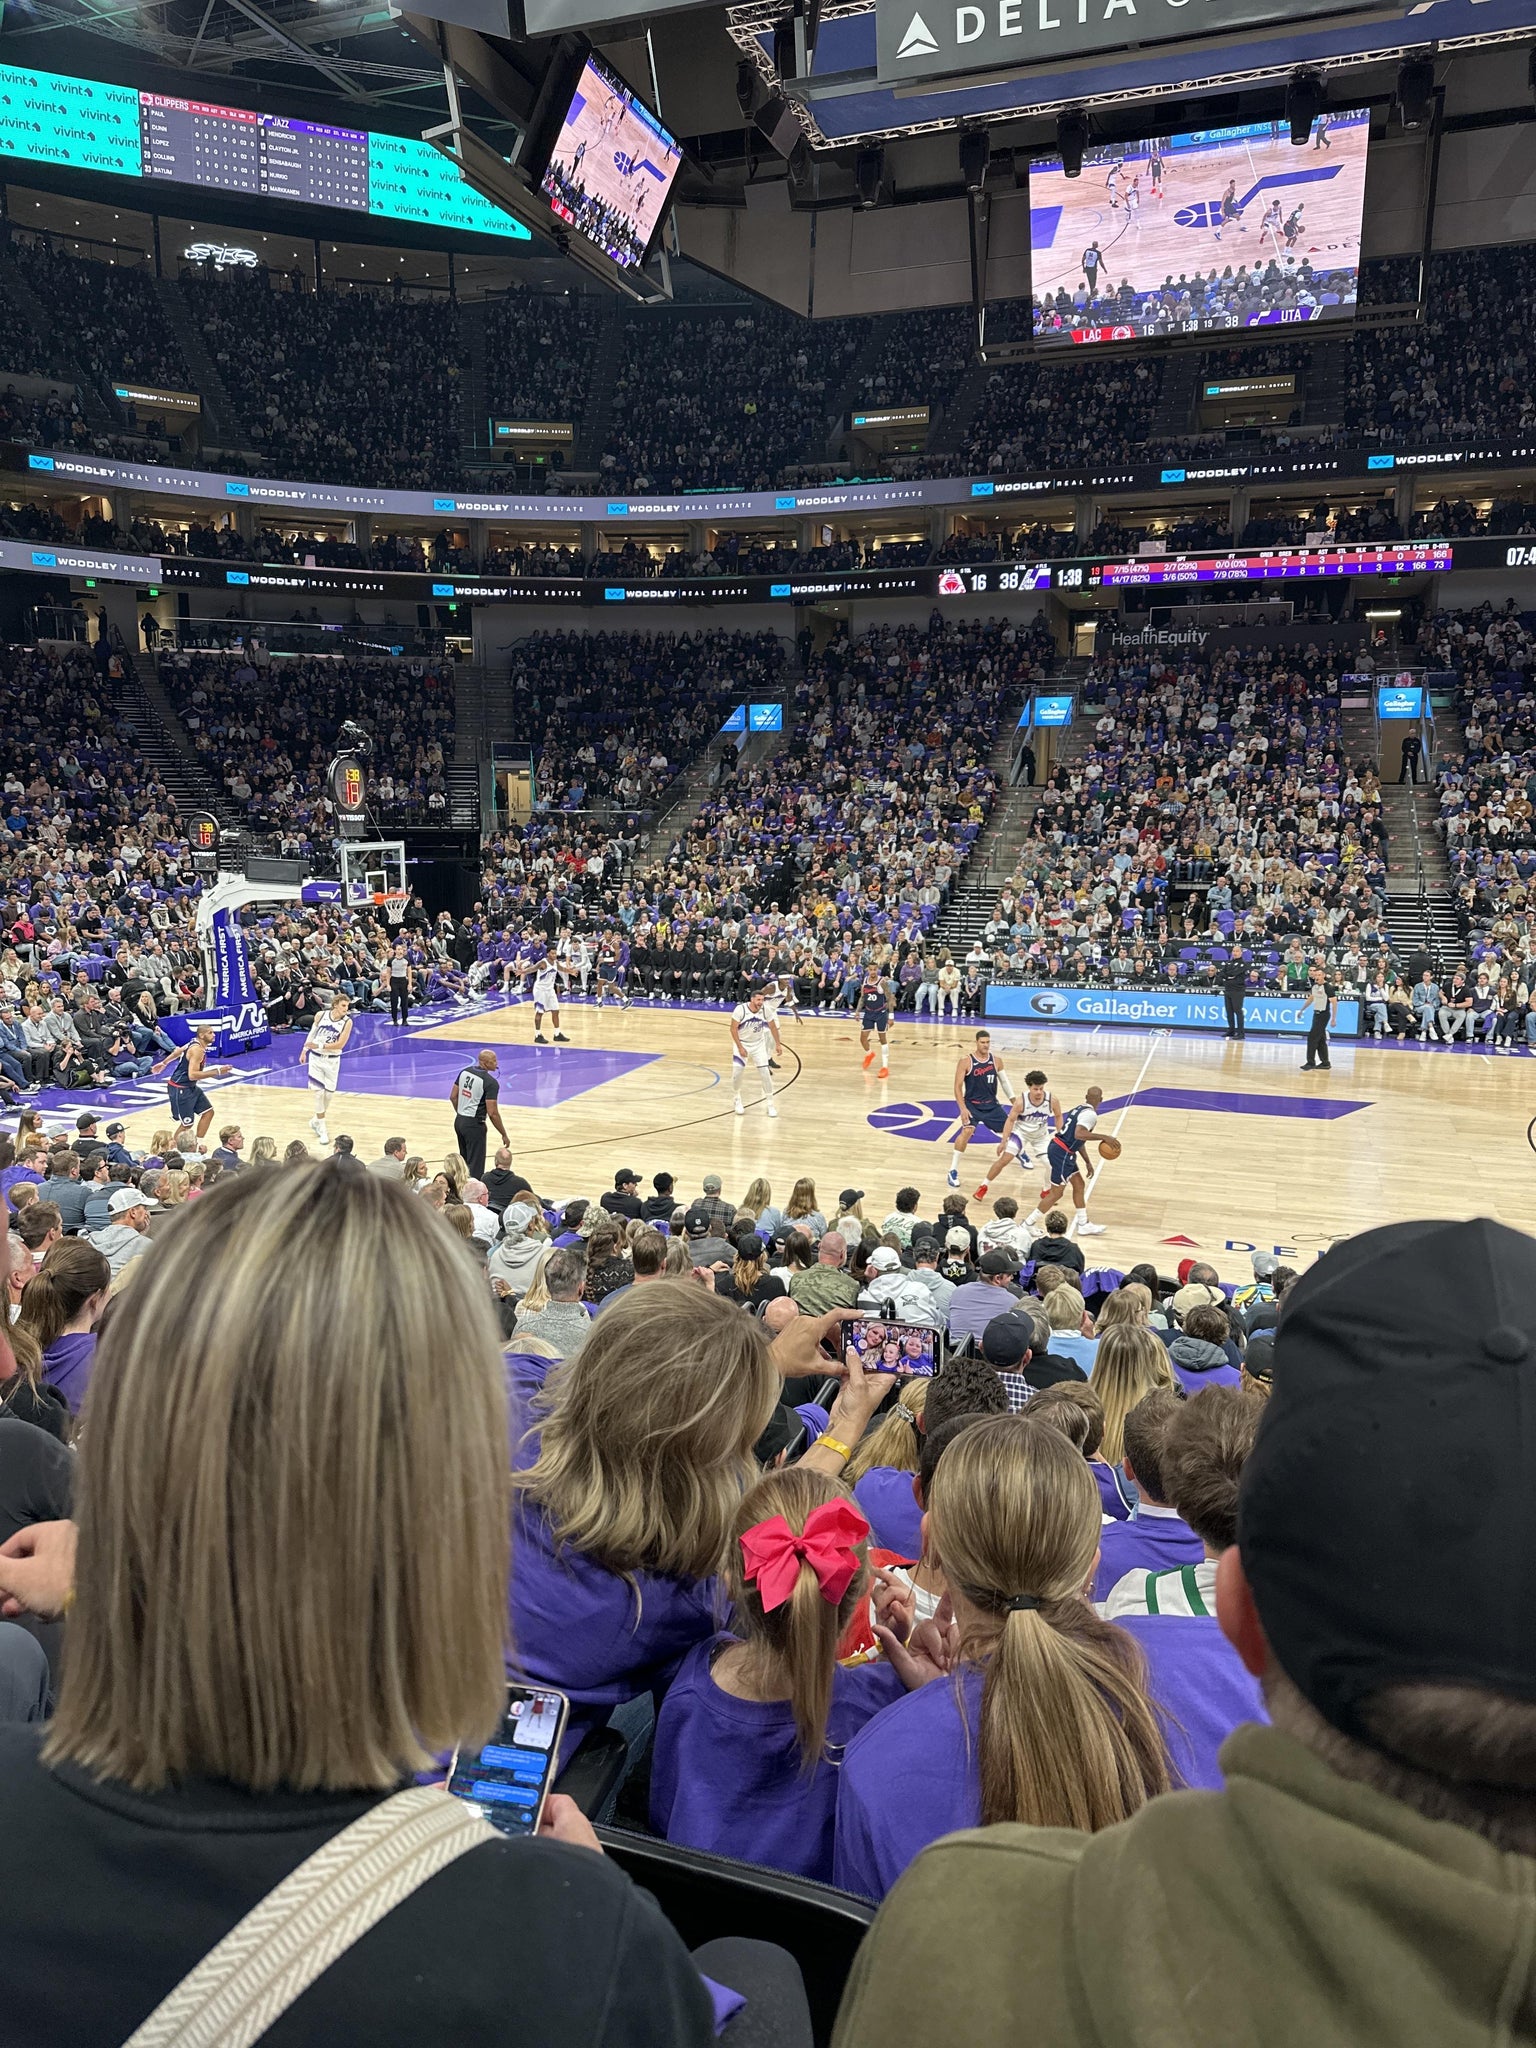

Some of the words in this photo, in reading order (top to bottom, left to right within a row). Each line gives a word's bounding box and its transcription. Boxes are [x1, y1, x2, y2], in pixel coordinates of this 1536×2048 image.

[50, 81, 83, 96] vivint
[24, 98, 57, 113] vivint
[106, 91, 137, 106] vivint
[155, 96, 190, 111] CLIPPERS
[80, 108, 112, 124] vivint
[272, 118, 290, 129] JAZZ
[53, 125, 86, 140] vivint
[268, 130, 297, 141] HENDRICKS
[1209, 125, 1251, 139] Gallagher
[108, 135, 139, 149] vivint
[152, 138, 170, 147] LOPEZ
[268, 143, 292, 154] CLAYTON
[371, 138, 399, 153] vivint
[27, 143, 60, 158] vivint
[82, 152, 114, 167] vivint
[394, 163, 421, 177] vivint
[371, 179, 399, 193] vivint
[417, 187, 444, 200] vivint
[462, 195, 488, 208] vivint
[394, 204, 421, 216] vivint
[439, 210, 466, 224] vivint
[483, 219, 509, 232] vivint
[1225, 316, 1239, 328] 38
[1281, 309, 1301, 321] UTA
[1142, 324, 1155, 336] 16
[1182, 320, 1199, 332] 1:38
[1203, 319, 1213, 329] 19
[1083, 330, 1101, 341] LAC
[1396, 453, 1464, 466] WOODLEY
[1469, 451, 1502, 459] REAL
[55, 461, 117, 478] WOODLEY
[122, 472, 150, 482] REAL
[158, 477, 200, 488] ESTATE
[1186, 467, 1249, 480] WOODLEY
[1254, 464, 1284, 474] REAL
[1292, 461, 1339, 471] ESTATE
[995, 480, 1052, 493] WOODLEY
[1057, 478, 1084, 487] REAL
[1092, 475, 1135, 485] ESTATE
[250, 487, 307, 499] WOODLEY
[312, 492, 338, 502] REAL
[346, 495, 385, 505] ESTATE
[797, 495, 848, 506] WOODLEY
[853, 493, 878, 501] REAL
[884, 490, 924, 499] ESTATE
[456, 502, 510, 512] WOODLEY
[514, 504, 541, 512] REAL
[546, 505, 585, 513] ESTATE
[629, 504, 681, 513] WOODLEY
[685, 504, 709, 512] REAL
[715, 502, 753, 511] ESTATE
[57, 557, 118, 571] WOODLEY
[123, 565, 151, 574] REAL
[159, 568, 201, 578] ESTATE
[1114, 566, 1130, 574] 7/15
[1130, 564, 1150, 574] (47%)
[1163, 563, 1176, 572] 2/7
[1177, 561, 1198, 571] (29%)
[1215, 560, 1230, 569] 0/0
[1230, 559, 1247, 569] (0%)
[1282, 558, 1288, 566] 2
[1300, 557, 1307, 565] 3
[1319, 556, 1325, 564] 3
[1376, 553, 1383, 561] 8
[1397, 552, 1404, 560] 0
[1415, 551, 1426, 559] 73
[1432, 550, 1447, 559] 166
[1057, 568, 1083, 587] 1:38
[1091, 566, 1101, 576] 19
[1111, 575, 1130, 584] 14/17
[1130, 574, 1150, 584] (82%)
[1163, 572, 1176, 581] 3/6
[1177, 571, 1198, 581] (50%)
[1214, 570, 1227, 579] 7/9
[1228, 569, 1248, 579] (78%)
[1282, 567, 1287, 576] 7
[1300, 567, 1306, 575] 8
[1318, 566, 1325, 574] 11
[1337, 565, 1344, 573] 6
[1376, 563, 1382, 571] 3
[1395, 562, 1404, 571] 12
[1412, 561, 1427, 570] 166
[1434, 560, 1445, 569] 73
[250, 575, 307, 587] WOODLEY
[311, 579, 338, 589] REAL
[346, 582, 385, 591] ESTATE
[792, 583, 843, 594] WOODLEY
[847, 582, 872, 591] REAL
[879, 580, 917, 589] ESTATE
[970, 573, 987, 591] 16
[999, 572, 1019, 590] 38
[1088, 576, 1101, 585] 1ST
[455, 587, 508, 597] WOODLEY
[513, 589, 538, 597] REAL
[545, 589, 582, 597] ESTATE
[626, 589, 677, 599] WOODLEY
[681, 589, 706, 597] REAL
[712, 588, 748, 596] ESTATE
[1111, 629, 1208, 647] HealthEquity
[218, 926, 227, 954] FIRST
[231, 927, 243, 954] FIRST
[221, 955, 230, 998] AMERICA
[238, 955, 248, 997] AMERICA
[867, 993, 877, 1001] 20
[1076, 998, 1177, 1019] Gallagher
[229, 1030, 252, 1040] AMERICA
[253, 1026, 267, 1035] FIRST
[974, 1065, 994, 1076] Clippers
[464, 1076, 475, 1090] 34
[987, 1074, 994, 1083] 11
